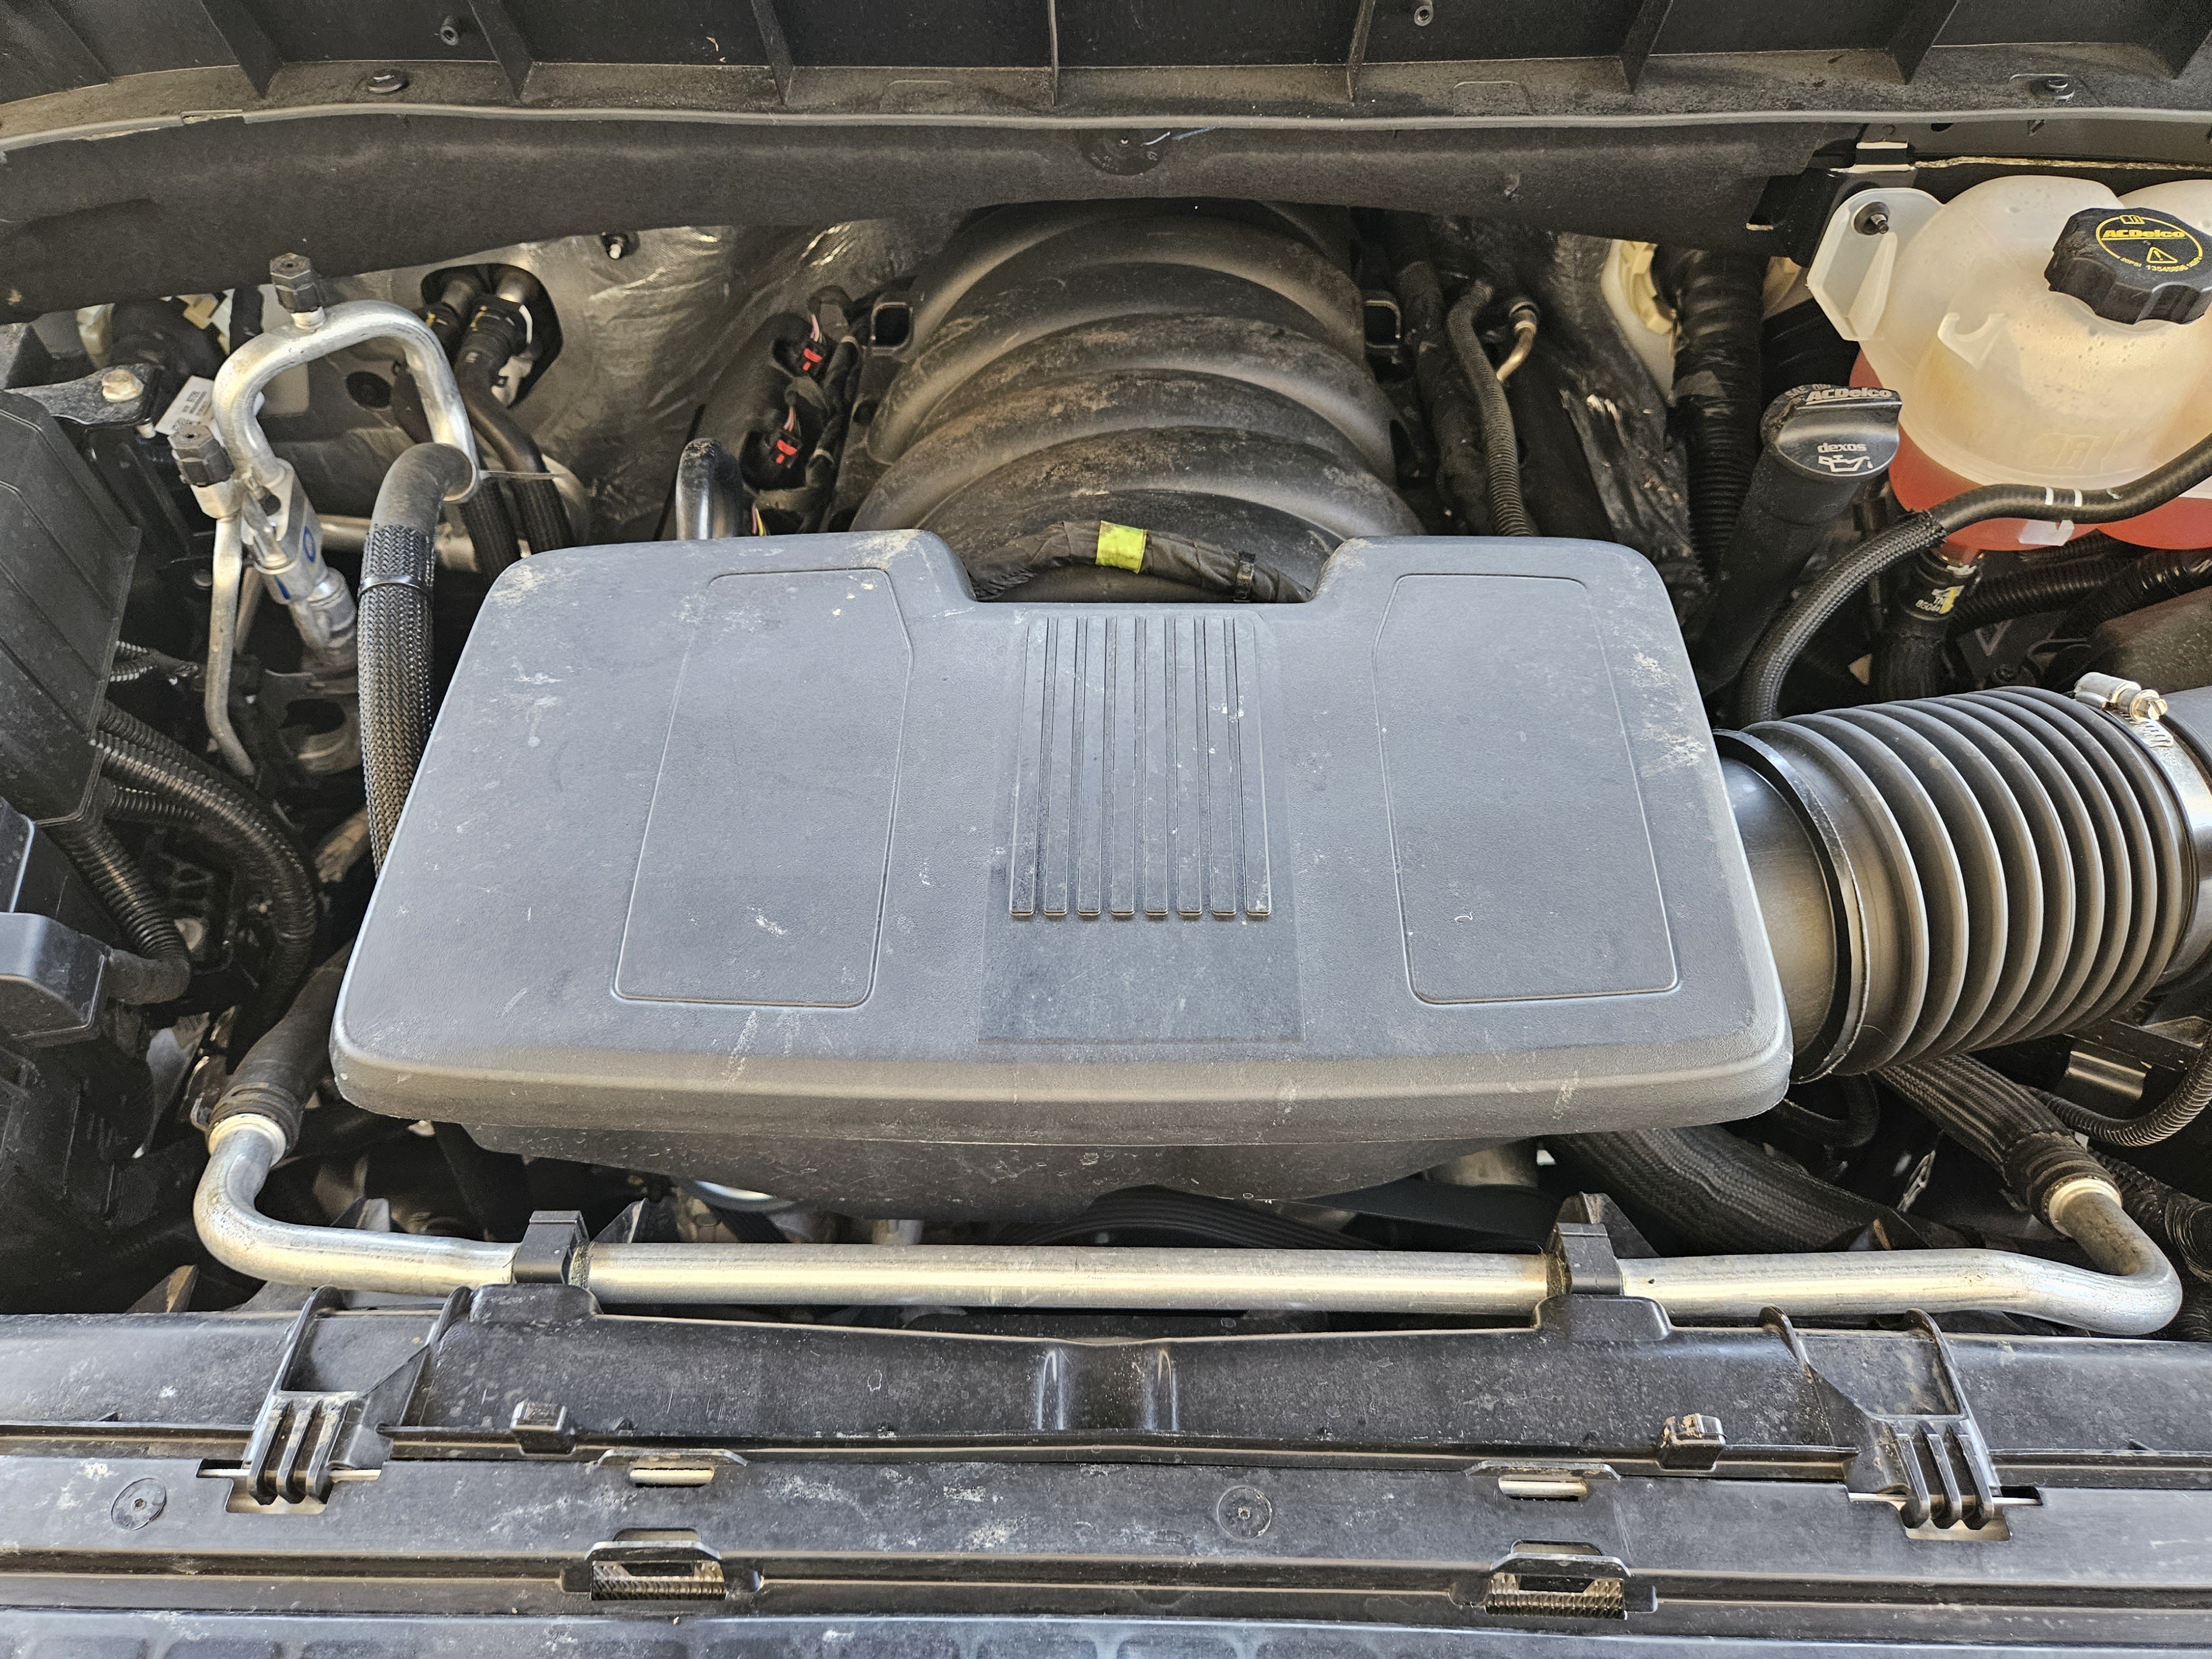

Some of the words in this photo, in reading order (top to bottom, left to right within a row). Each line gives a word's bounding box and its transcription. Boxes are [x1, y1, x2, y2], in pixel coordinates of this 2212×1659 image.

[2103, 229, 2186, 238] ACDelco
[1805, 387, 1893, 402] ACDelco
[1817, 442, 1867, 453] dexos
